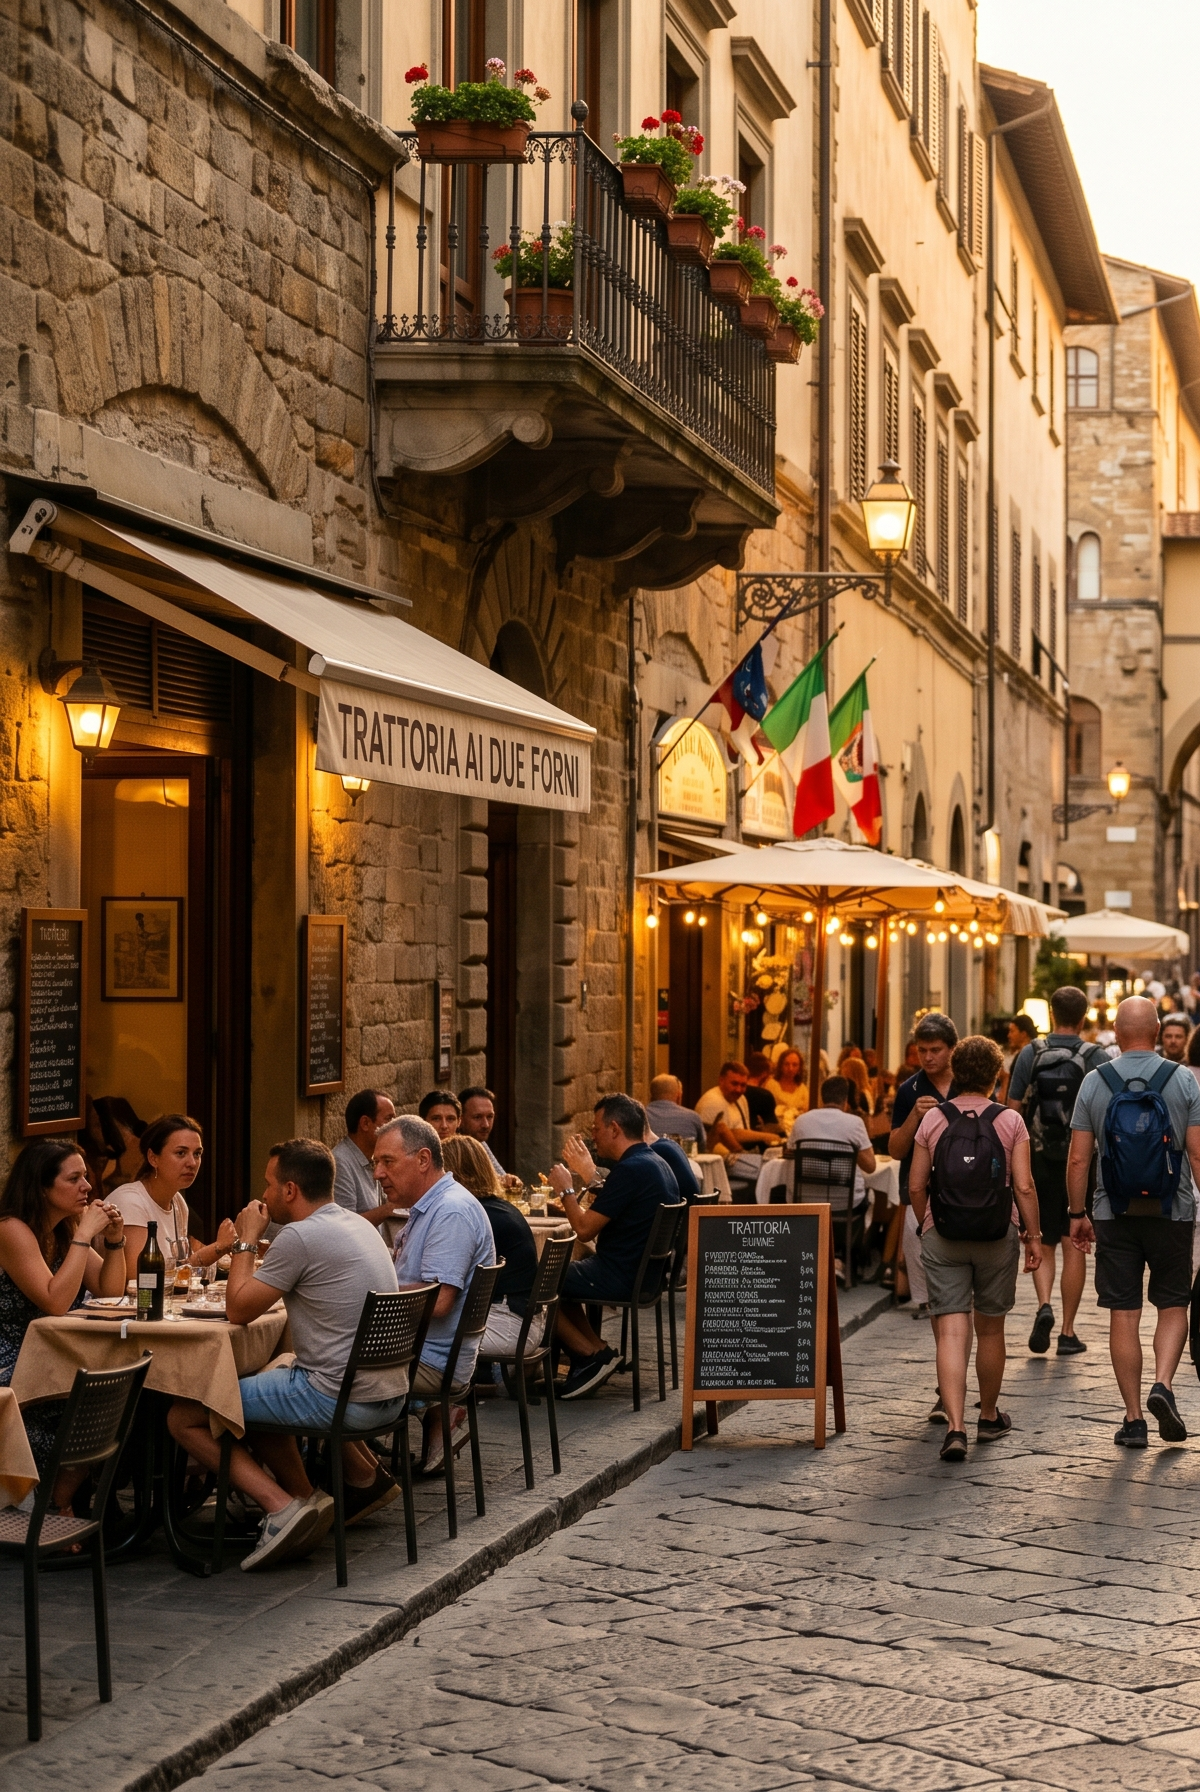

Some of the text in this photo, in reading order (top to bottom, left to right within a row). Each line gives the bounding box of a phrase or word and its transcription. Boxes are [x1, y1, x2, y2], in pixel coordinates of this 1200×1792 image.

[337, 702, 579, 798] TRATTORIA AI DUE FORNI
[727, 1221, 791, 1235] TRATTORIA
